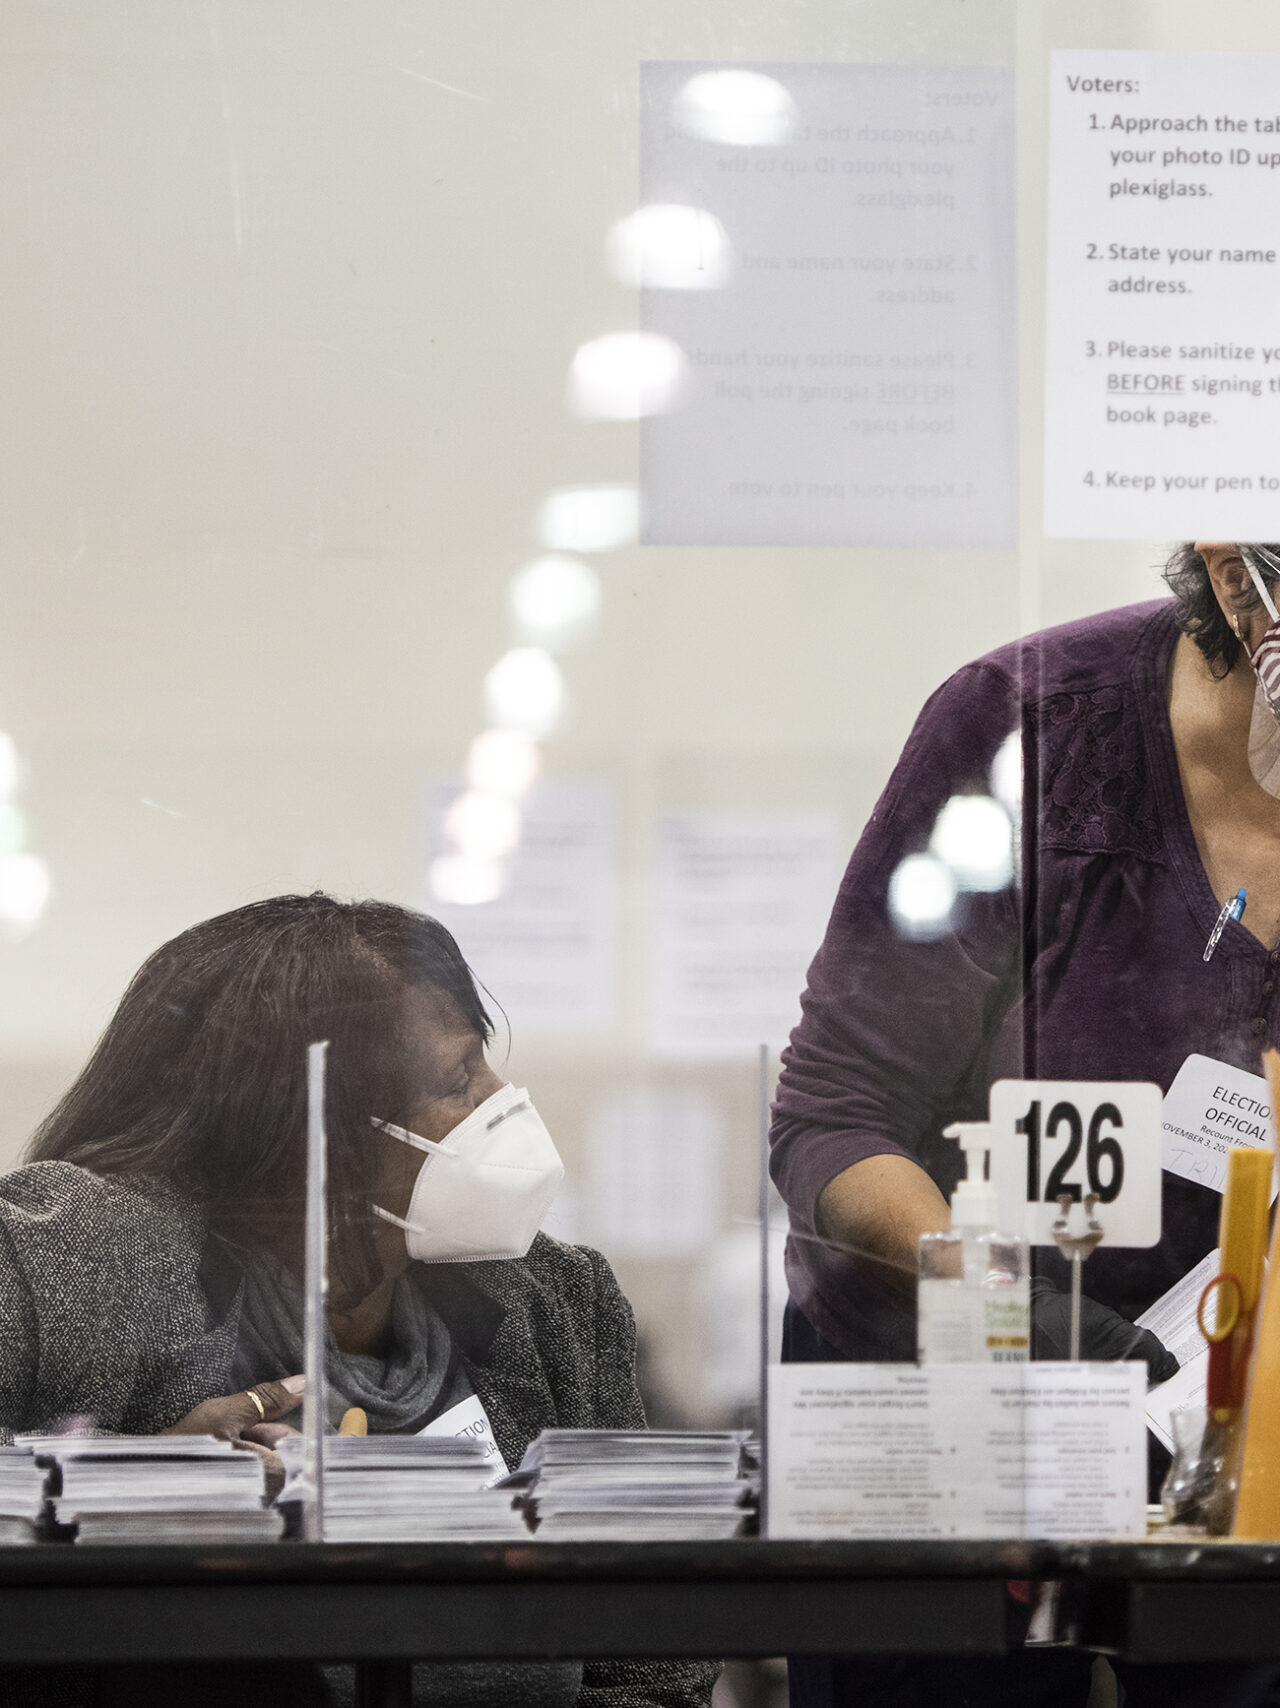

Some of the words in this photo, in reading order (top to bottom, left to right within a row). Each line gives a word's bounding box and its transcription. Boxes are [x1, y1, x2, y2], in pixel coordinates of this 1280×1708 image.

[1066, 75, 1140, 94] Voters:
[1088, 113, 1106, 131] 1.
[1109, 113, 1209, 135] Approach
[1214, 115, 1248, 133] the
[1109, 149, 1156, 167] your
[1162, 146, 1223, 168] photo
[1229, 148, 1251, 166] ID
[1109, 178, 1213, 201] plexiglass.
[1086, 242, 1104, 261] 2.
[1108, 243, 1161, 261] State
[1167, 248, 1213, 265] your
[1219, 249, 1276, 264] name
[1107, 275, 1192, 294] address.
[1085, 340, 1102, 358] 3.
[1107, 340, 1172, 359] Please
[1178, 343, 1256, 360] sanitize
[1106, 373, 1186, 395] BEFORE
[1192, 375, 1262, 397] signing
[1106, 405, 1157, 424] book
[1163, 410, 1218, 429] page.
[1082, 471, 1101, 488] 4.
[1106, 471, 1156, 492] Keep
[1162, 476, 1208, 492] your
[1215, 477, 1252, 493] pen
[1259, 475, 1280, 491] to
[1212, 1086, 1273, 1121] ELECTIO
[1162, 1121, 1204, 1145] OVEMBER
[1200, 1124, 1234, 1144] Recount
[1205, 1107, 1267, 1141] OFFICIAL
[1015, 1100, 1125, 1204] 126
